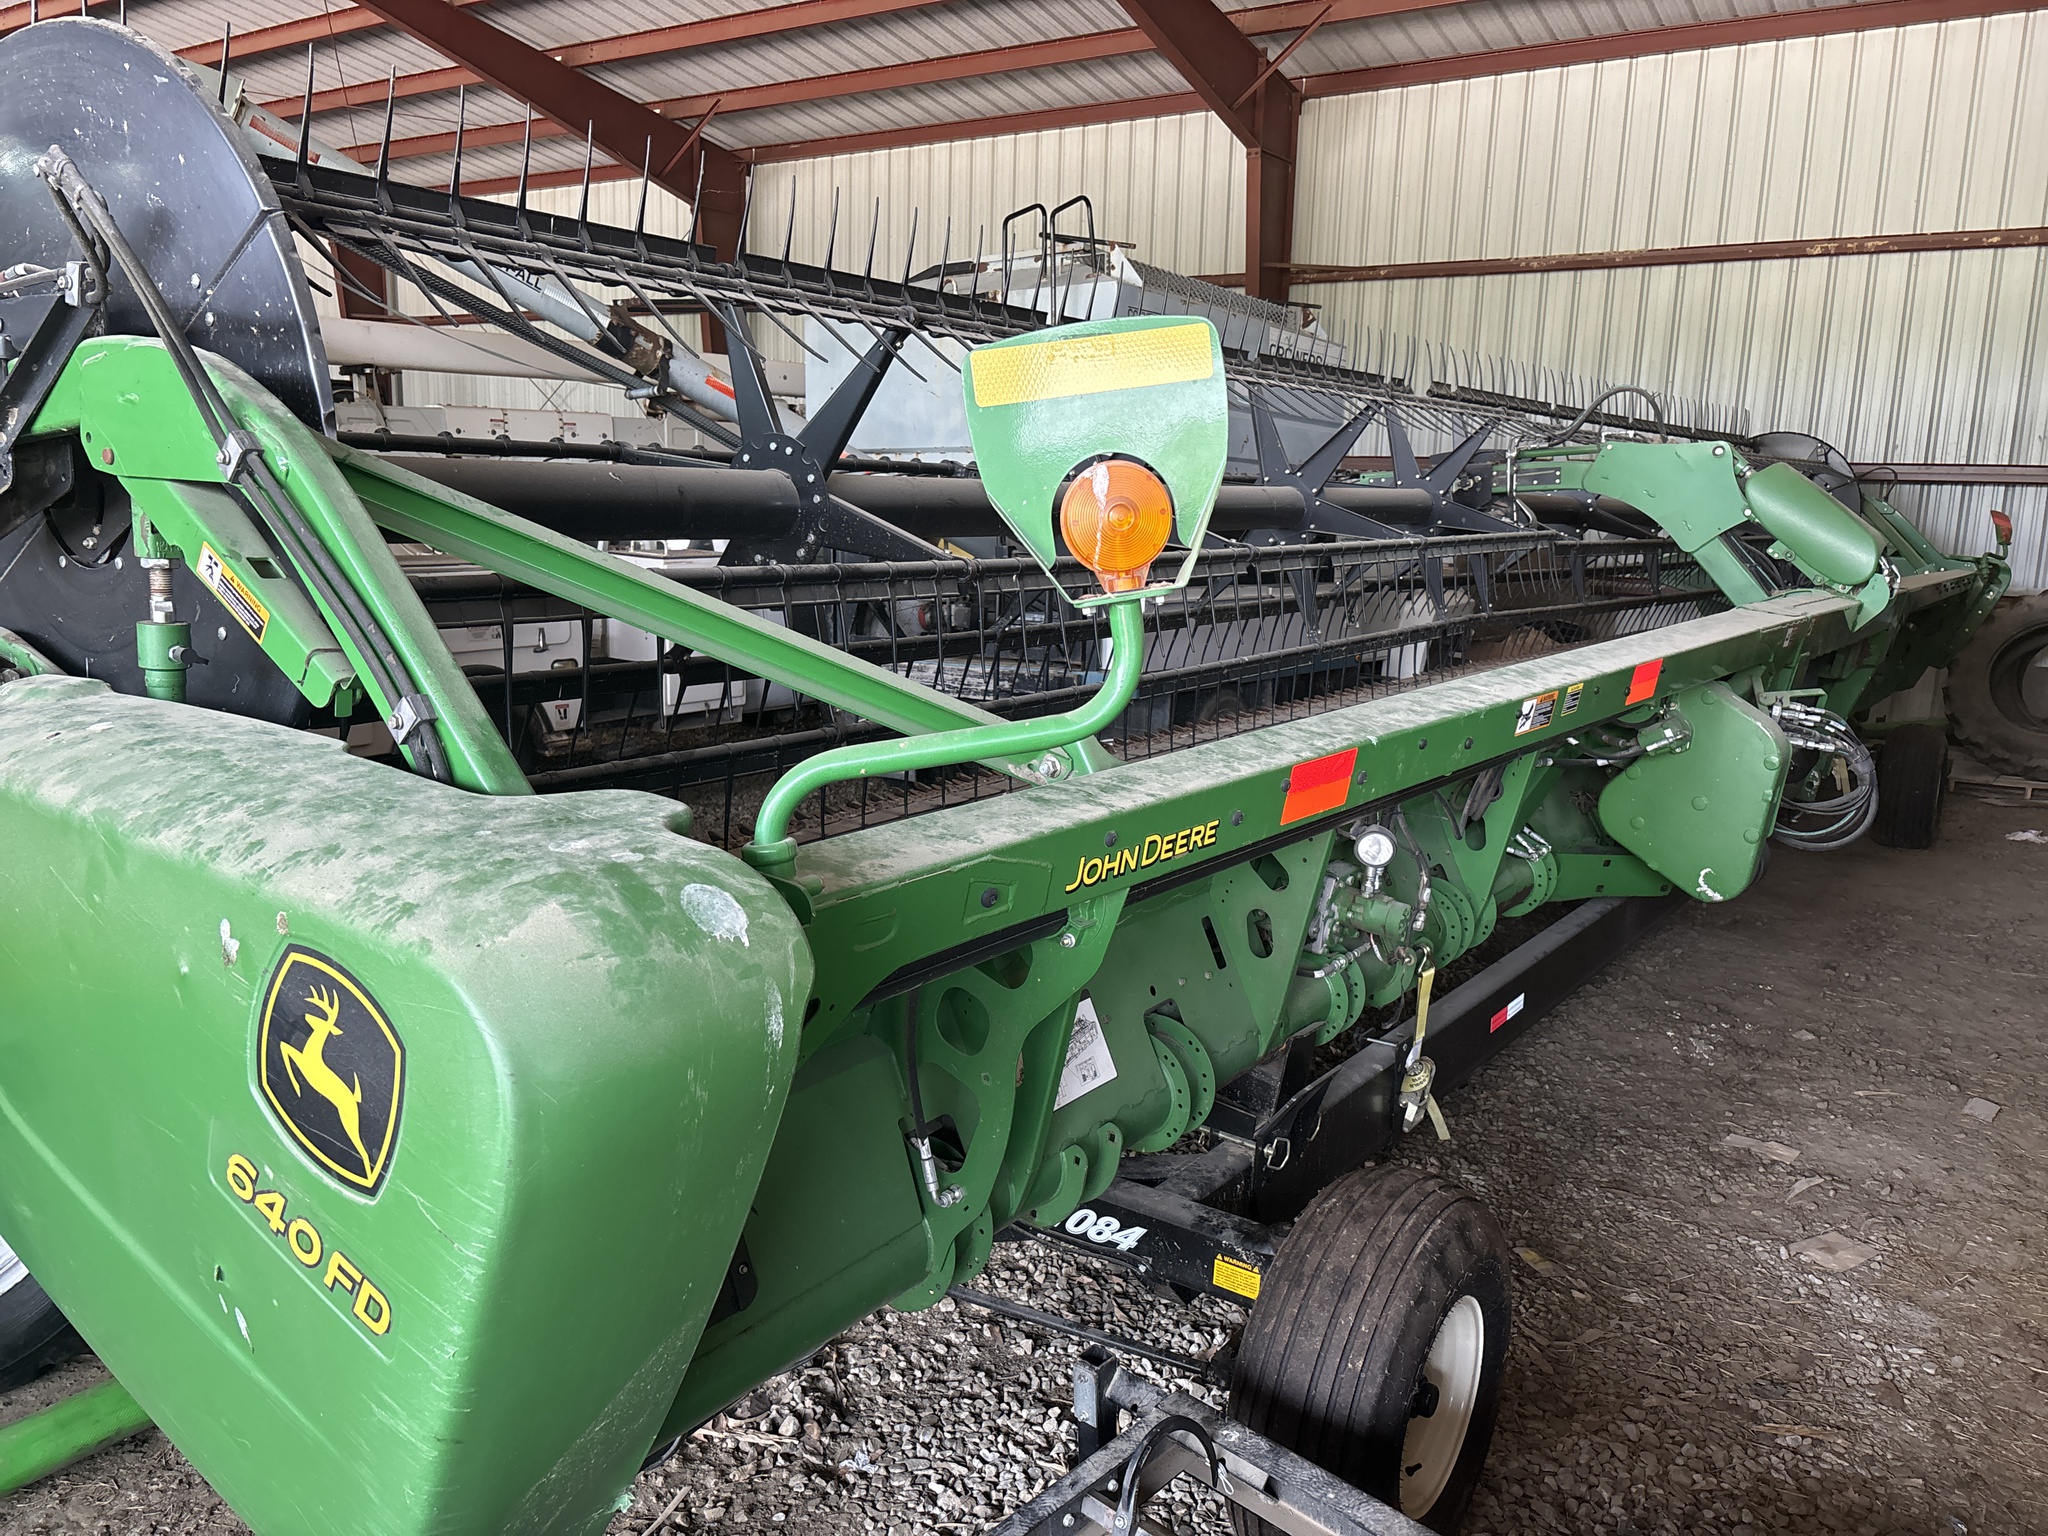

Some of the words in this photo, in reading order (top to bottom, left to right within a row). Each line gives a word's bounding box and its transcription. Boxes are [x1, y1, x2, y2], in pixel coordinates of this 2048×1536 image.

[236, 581, 262, 613] WARNING
[1065, 844, 1141, 894] JOHN
[1141, 819, 1220, 868] DEERE
[226, 1153, 324, 1269] 640
[323, 1251, 392, 1336] FD
[1054, 1208, 1149, 1251] 084
[1223, 1255, 1253, 1271] WARNING
